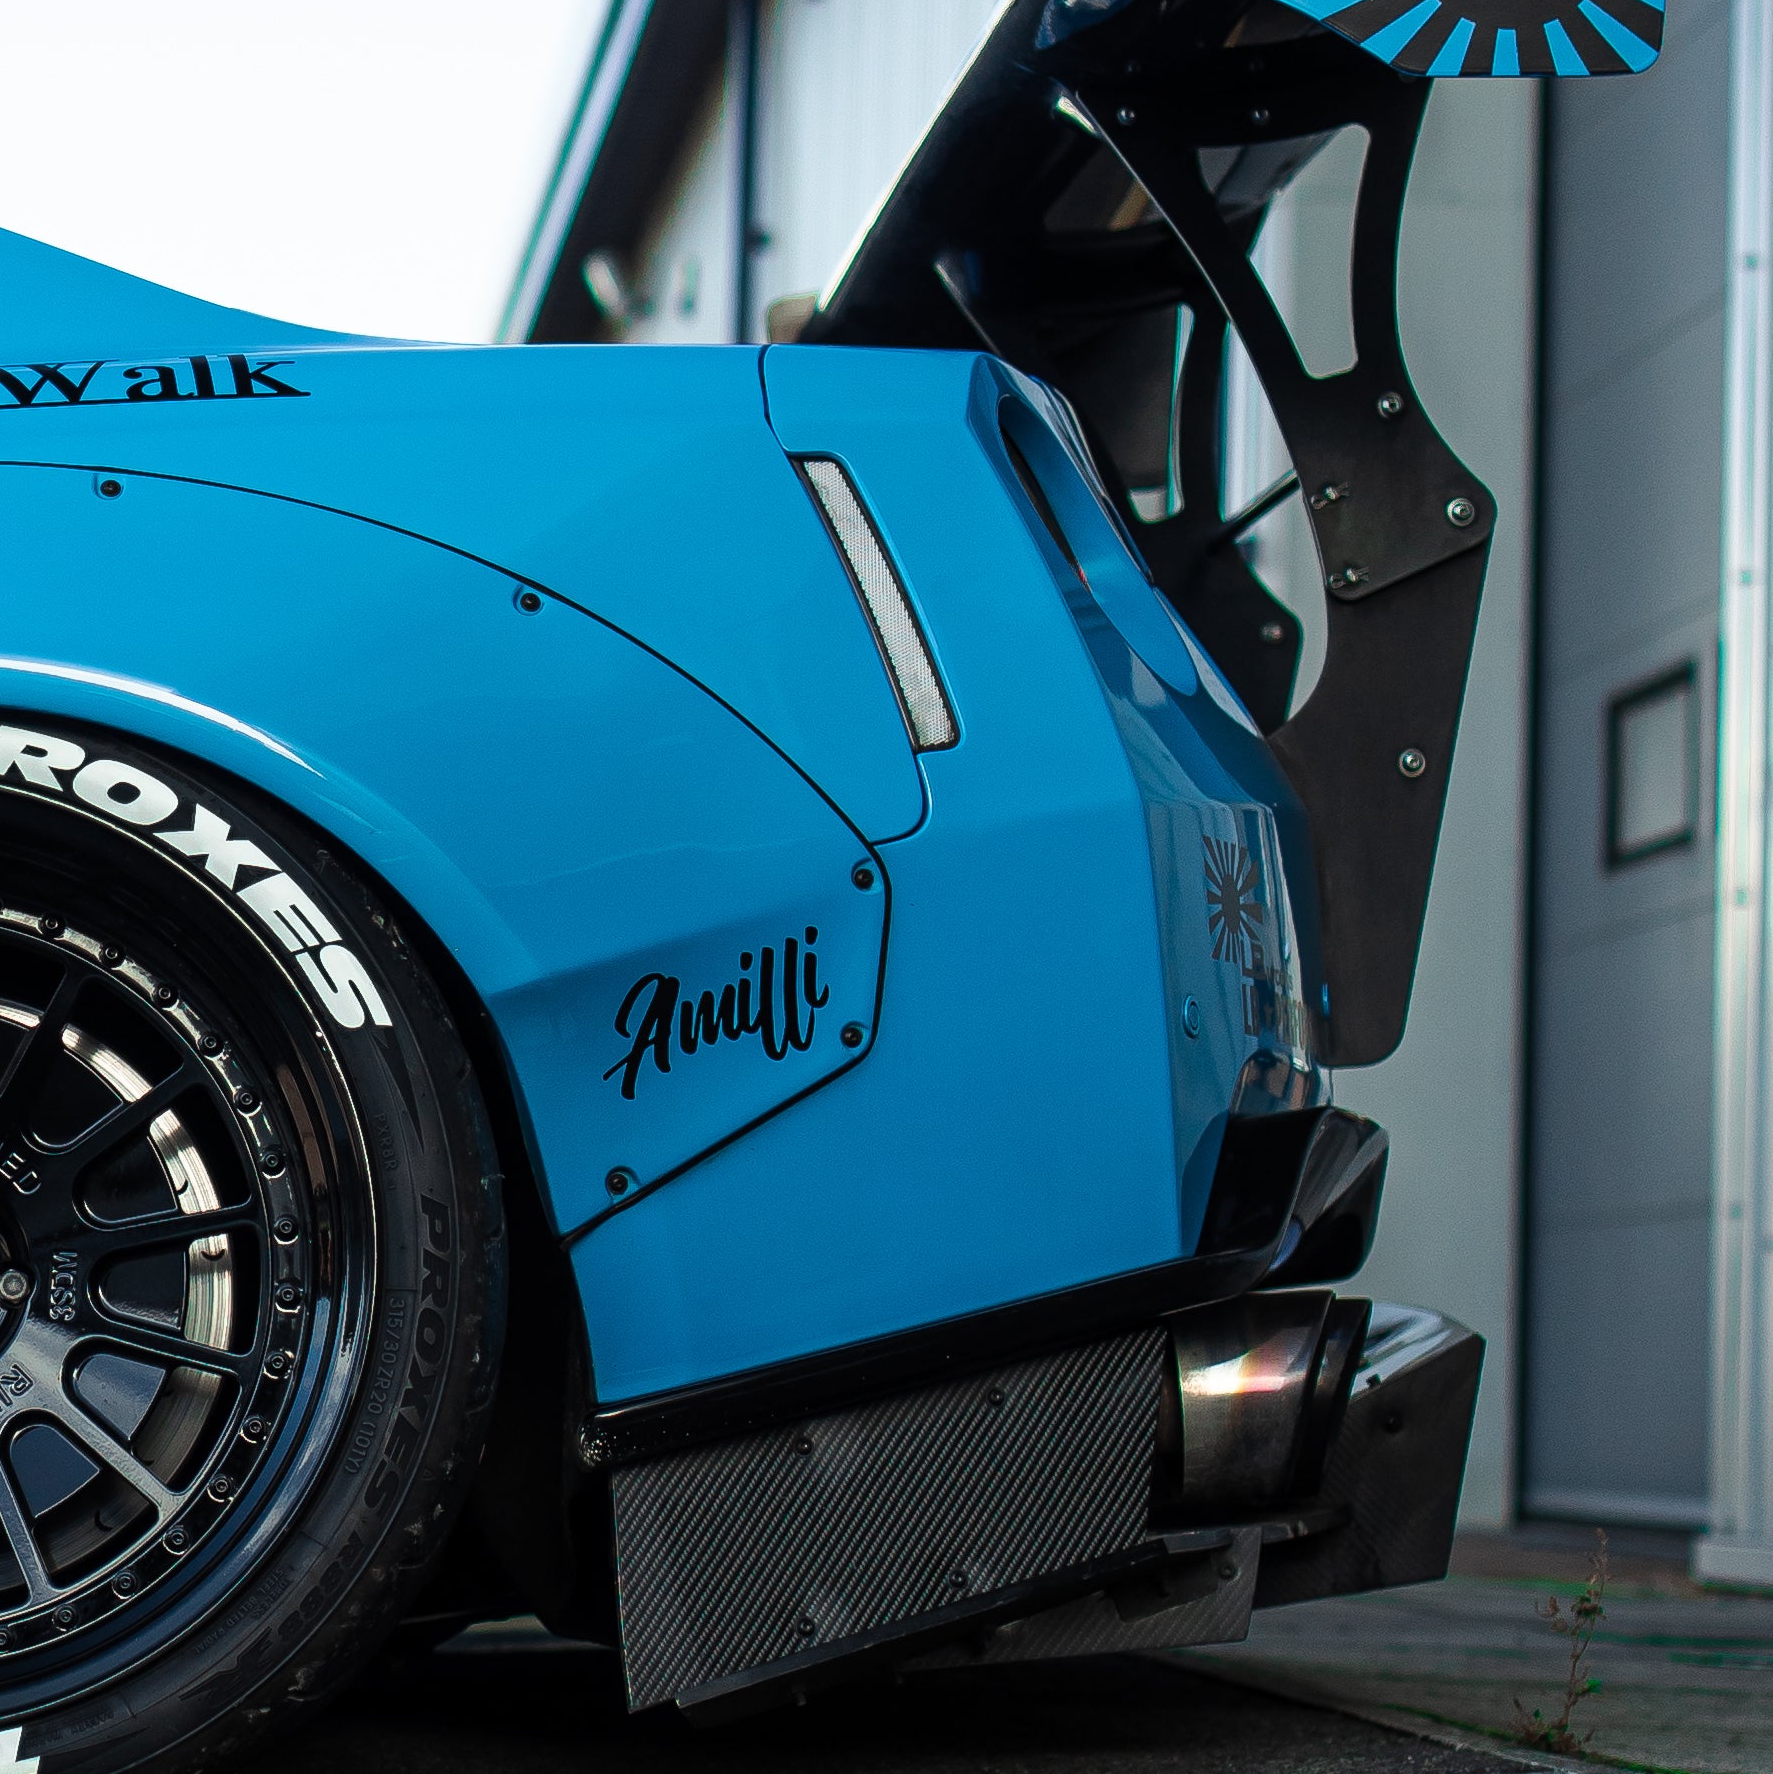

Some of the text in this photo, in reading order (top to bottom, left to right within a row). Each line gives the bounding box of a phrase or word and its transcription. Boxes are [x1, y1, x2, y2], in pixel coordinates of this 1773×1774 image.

[602, 925, 829, 1100] Amilli
[48, 1250, 78, 1321] 3SDM
[363, 1193, 452, 1520] PROXES
[344, 1420, 376, 1474] (101Y)
